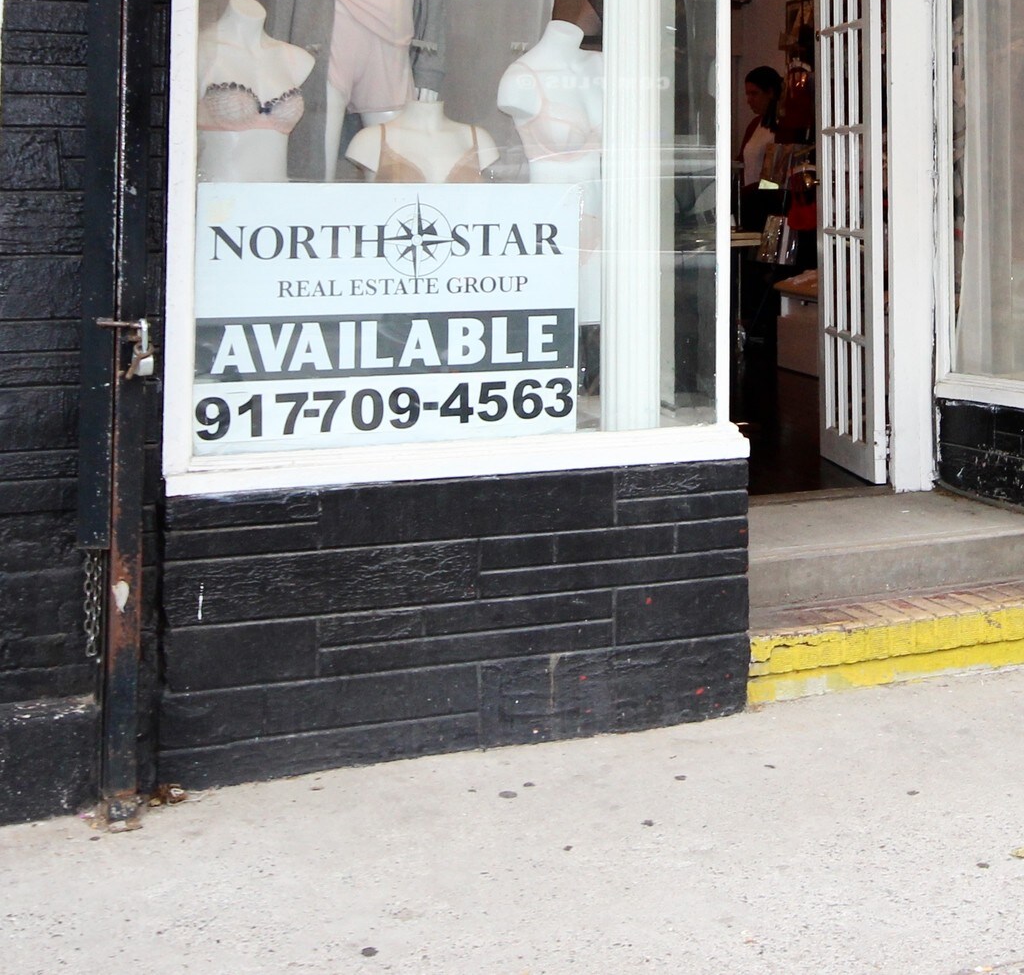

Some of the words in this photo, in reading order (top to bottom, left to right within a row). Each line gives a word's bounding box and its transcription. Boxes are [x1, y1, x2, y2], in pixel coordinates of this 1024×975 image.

[209, 224, 388, 261] NORTH
[450, 222, 564, 257] STAR
[277, 279, 342, 298] REAL
[349, 277, 439, 297] ESTATE
[446, 275, 529, 295] GROUP
[210, 314, 559, 375] AVAILABLE
[194, 377, 574, 441] 917-709-4563
